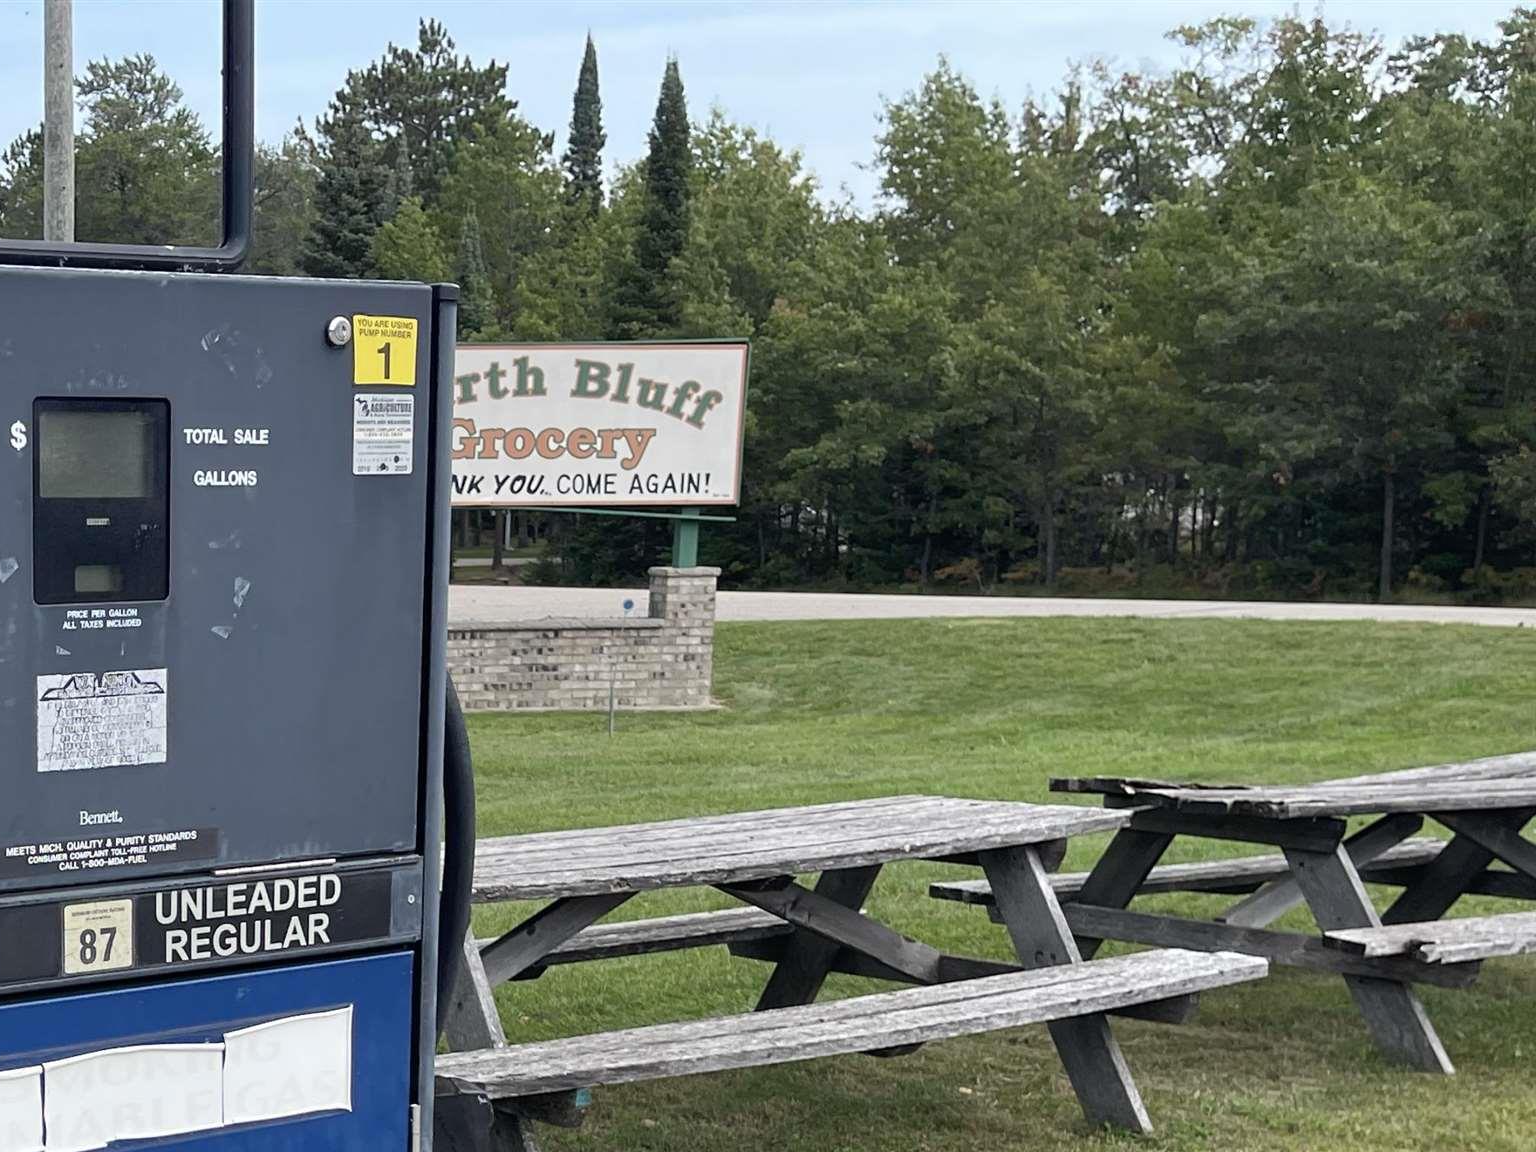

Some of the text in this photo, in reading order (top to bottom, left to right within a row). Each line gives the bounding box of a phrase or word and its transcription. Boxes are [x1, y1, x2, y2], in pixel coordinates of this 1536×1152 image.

[358, 319, 414, 330] YOU ARE USING
[359, 328, 412, 339] PUMP NUMBER
[377, 342, 391, 380] 1
[454, 355, 724, 430] rth Bluff
[10, 420, 270, 452] $ TOTAL SALE
[451, 418, 657, 471] Grocery
[193, 470, 258, 486] GALLONS
[557, 473, 617, 495] COME
[629, 472, 712, 495] AGAIN!
[62, 617, 142, 630] ALL TAXES INCLUDED
[66, 608, 138, 620] PRICE PER GALLON
[5, 830, 197, 857] MEETS MICH. QUALITY & PURITY STANDARDS
[27, 842, 178, 865] CONSUMER COMPLAINT TOLL-FREE HOTLINE
[58, 855, 147, 871] CALL 1-800-MDA-FUEL
[154, 874, 342, 925] UNLEADED
[79, 912, 331, 966] 87 REGULAR
